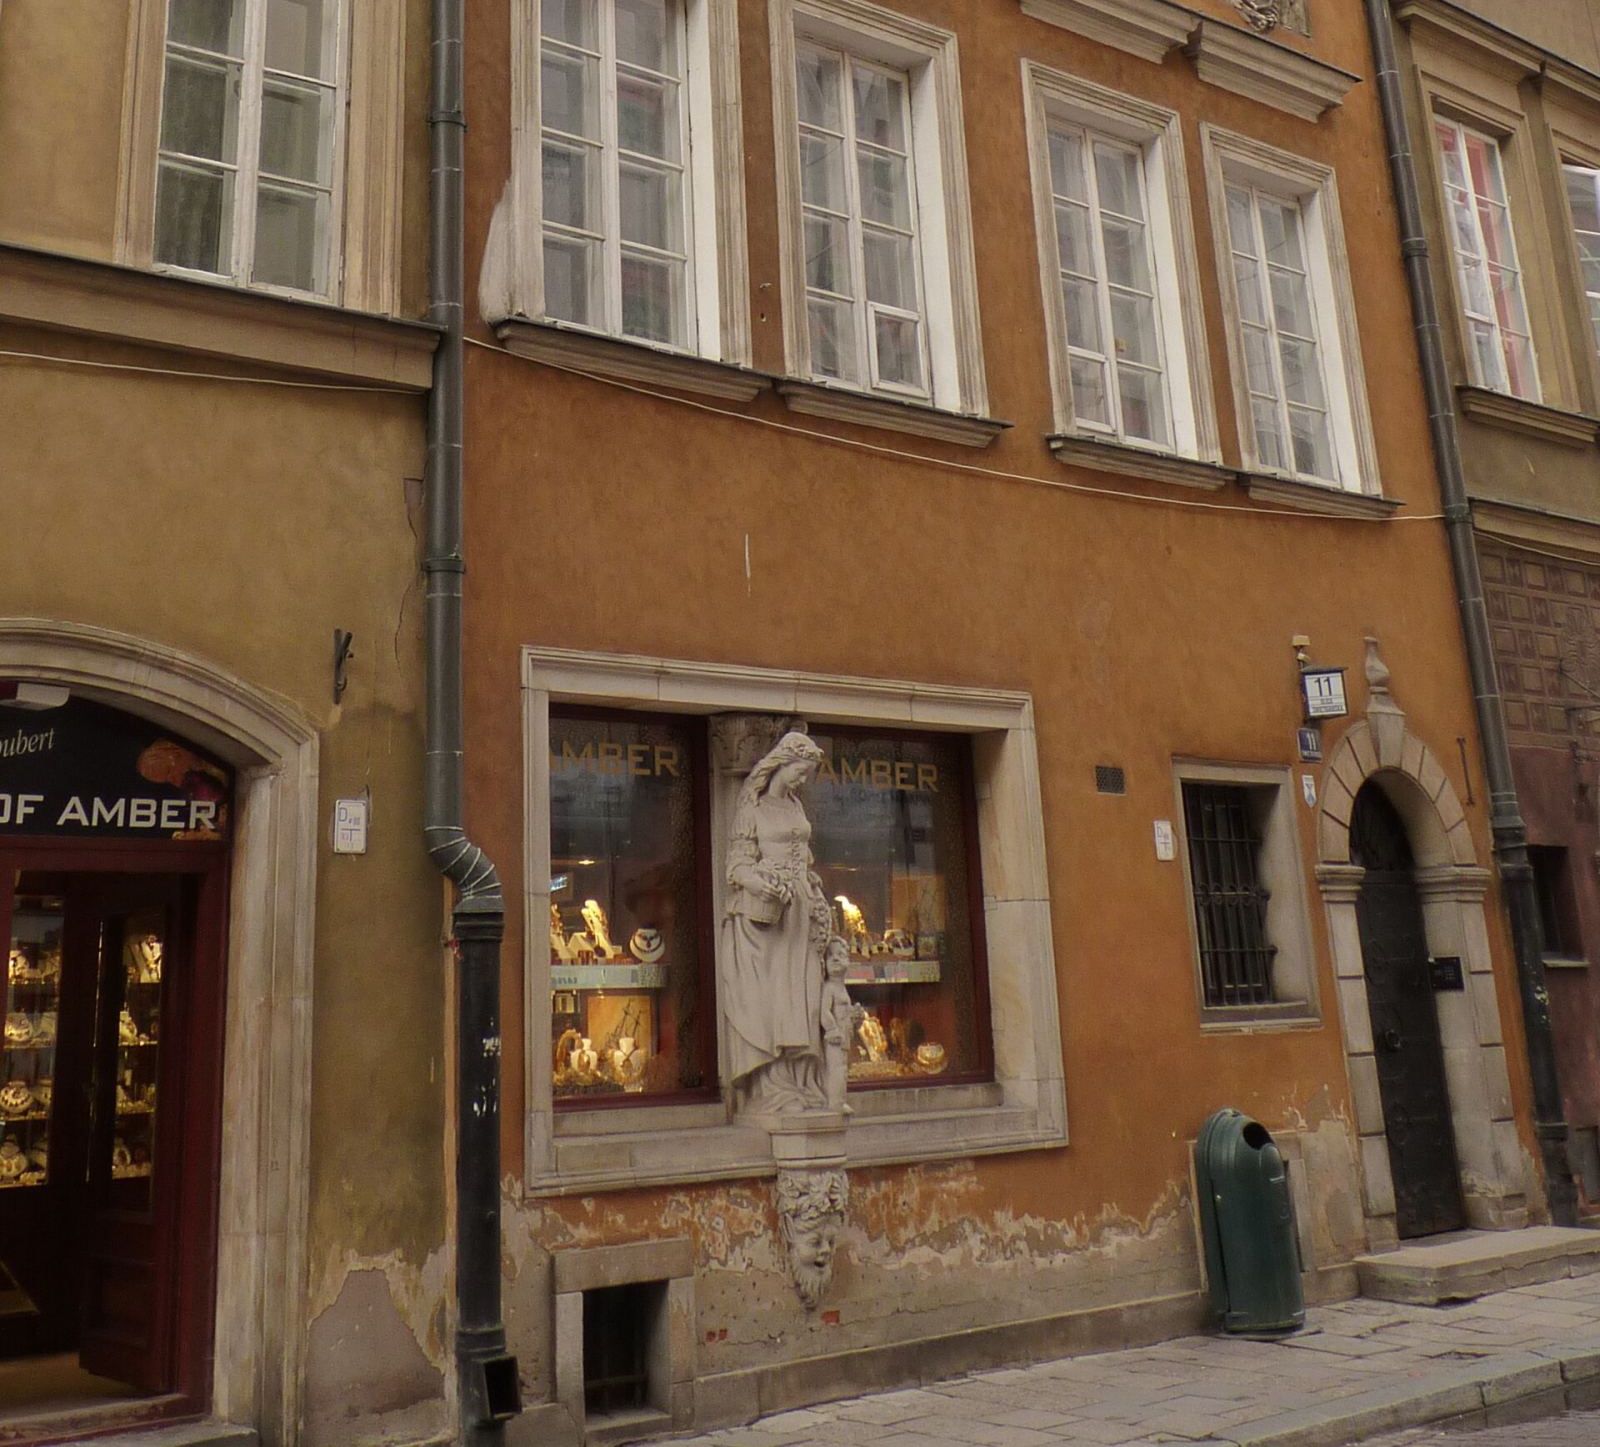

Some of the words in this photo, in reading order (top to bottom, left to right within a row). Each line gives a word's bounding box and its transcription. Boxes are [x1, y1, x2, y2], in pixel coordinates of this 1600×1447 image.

[1314, 676, 1332, 697] 11
[0, 727, 54, 758] ubert
[815, 758, 939, 793] AMBER
[56, 796, 216, 830] AMBER
